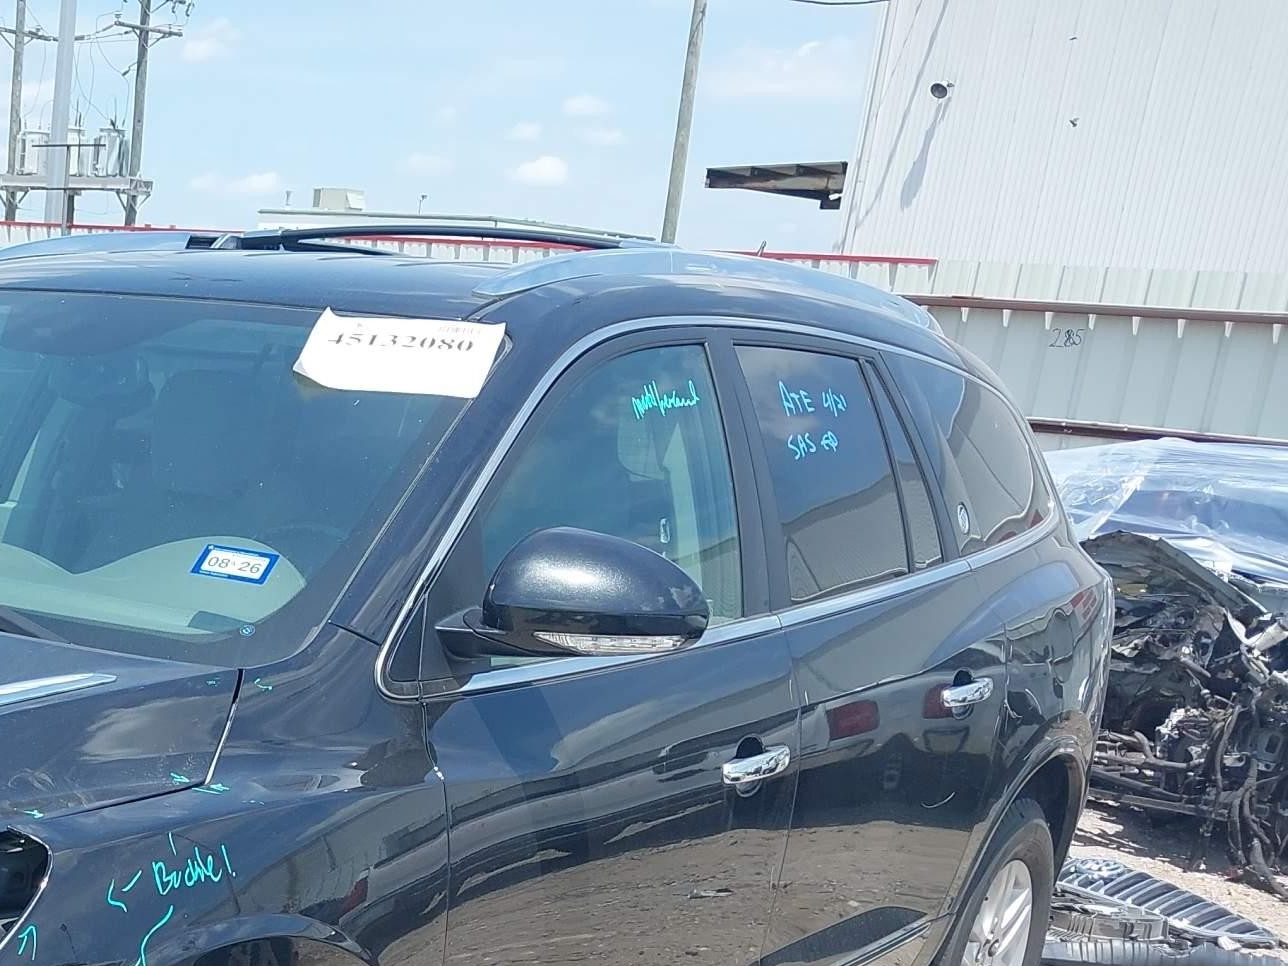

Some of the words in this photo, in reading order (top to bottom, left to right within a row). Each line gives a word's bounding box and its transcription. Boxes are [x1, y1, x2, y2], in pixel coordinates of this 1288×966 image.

[328, 332, 474, 352] 45132080
[787, 432, 817, 460] SAS
[207, 556, 231, 569] 08
[238, 561, 263, 574] 26
